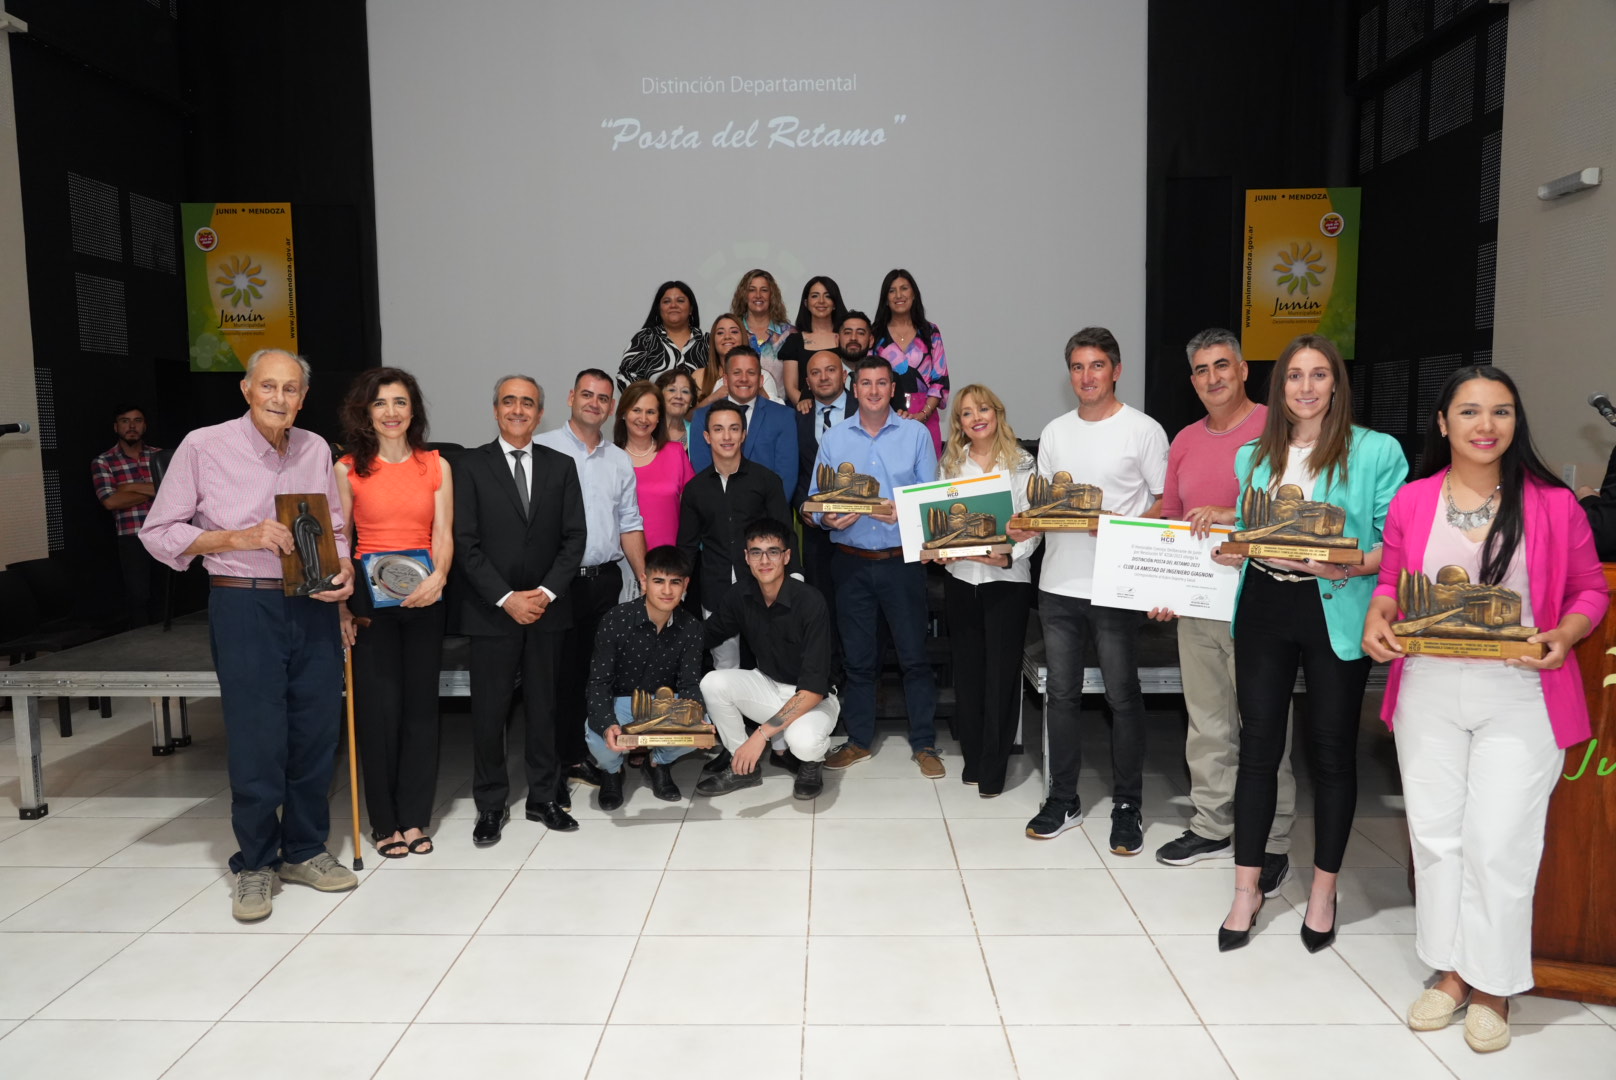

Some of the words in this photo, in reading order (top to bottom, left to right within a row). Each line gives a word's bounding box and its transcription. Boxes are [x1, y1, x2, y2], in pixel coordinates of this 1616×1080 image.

[641, 76, 725, 94] Distinción
[730, 74, 858, 96] Departamental
[712, 119, 759, 148] del
[1254, 194, 1277, 202] JUNIN
[1288, 193, 1328, 201] MENDOZA
[248, 207, 286, 215] MENDOZA
[1245, 225, 1255, 329] www.juninmendoza.gov.ar
[286, 237, 296, 339] www.juninmendoza.gov.ar
[1131, 556, 1154, 564] DISTINCIÓN
[1140, 565, 1160, 573] AMISTAD
[1166, 568, 1191, 576] INGENIERO
[1191, 570, 1214, 578] GIAGNONI
